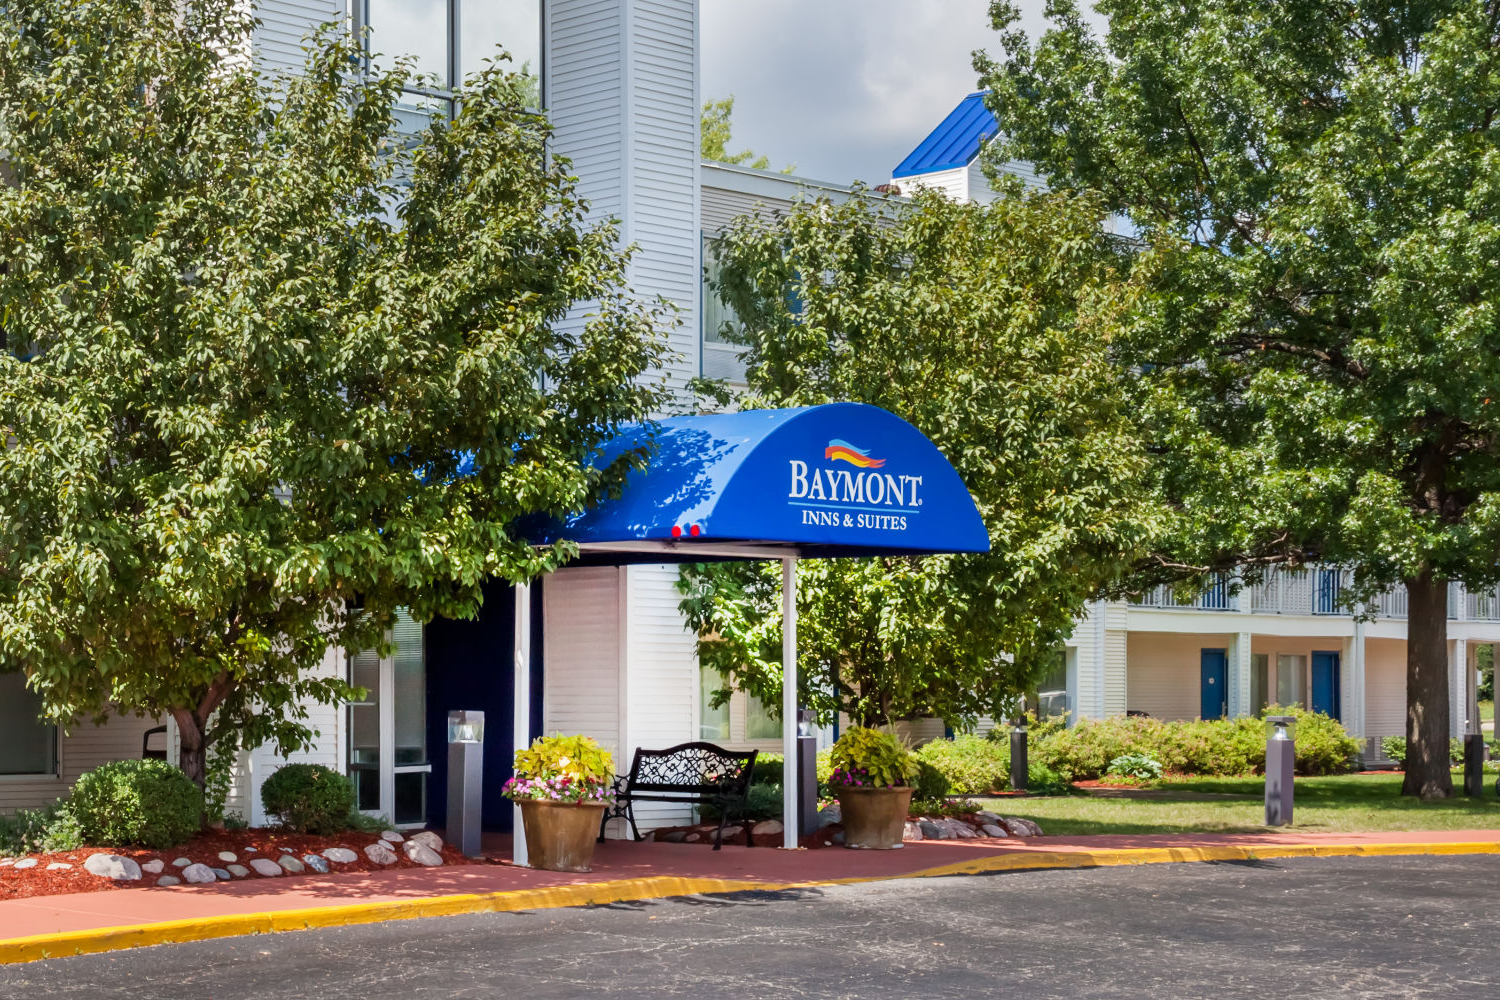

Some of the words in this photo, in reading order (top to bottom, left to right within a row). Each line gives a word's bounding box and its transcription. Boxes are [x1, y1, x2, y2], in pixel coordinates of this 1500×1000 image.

[802, 509, 840, 527] INNS
[842, 513, 854, 528] &
[857, 513, 907, 530] SUITES
